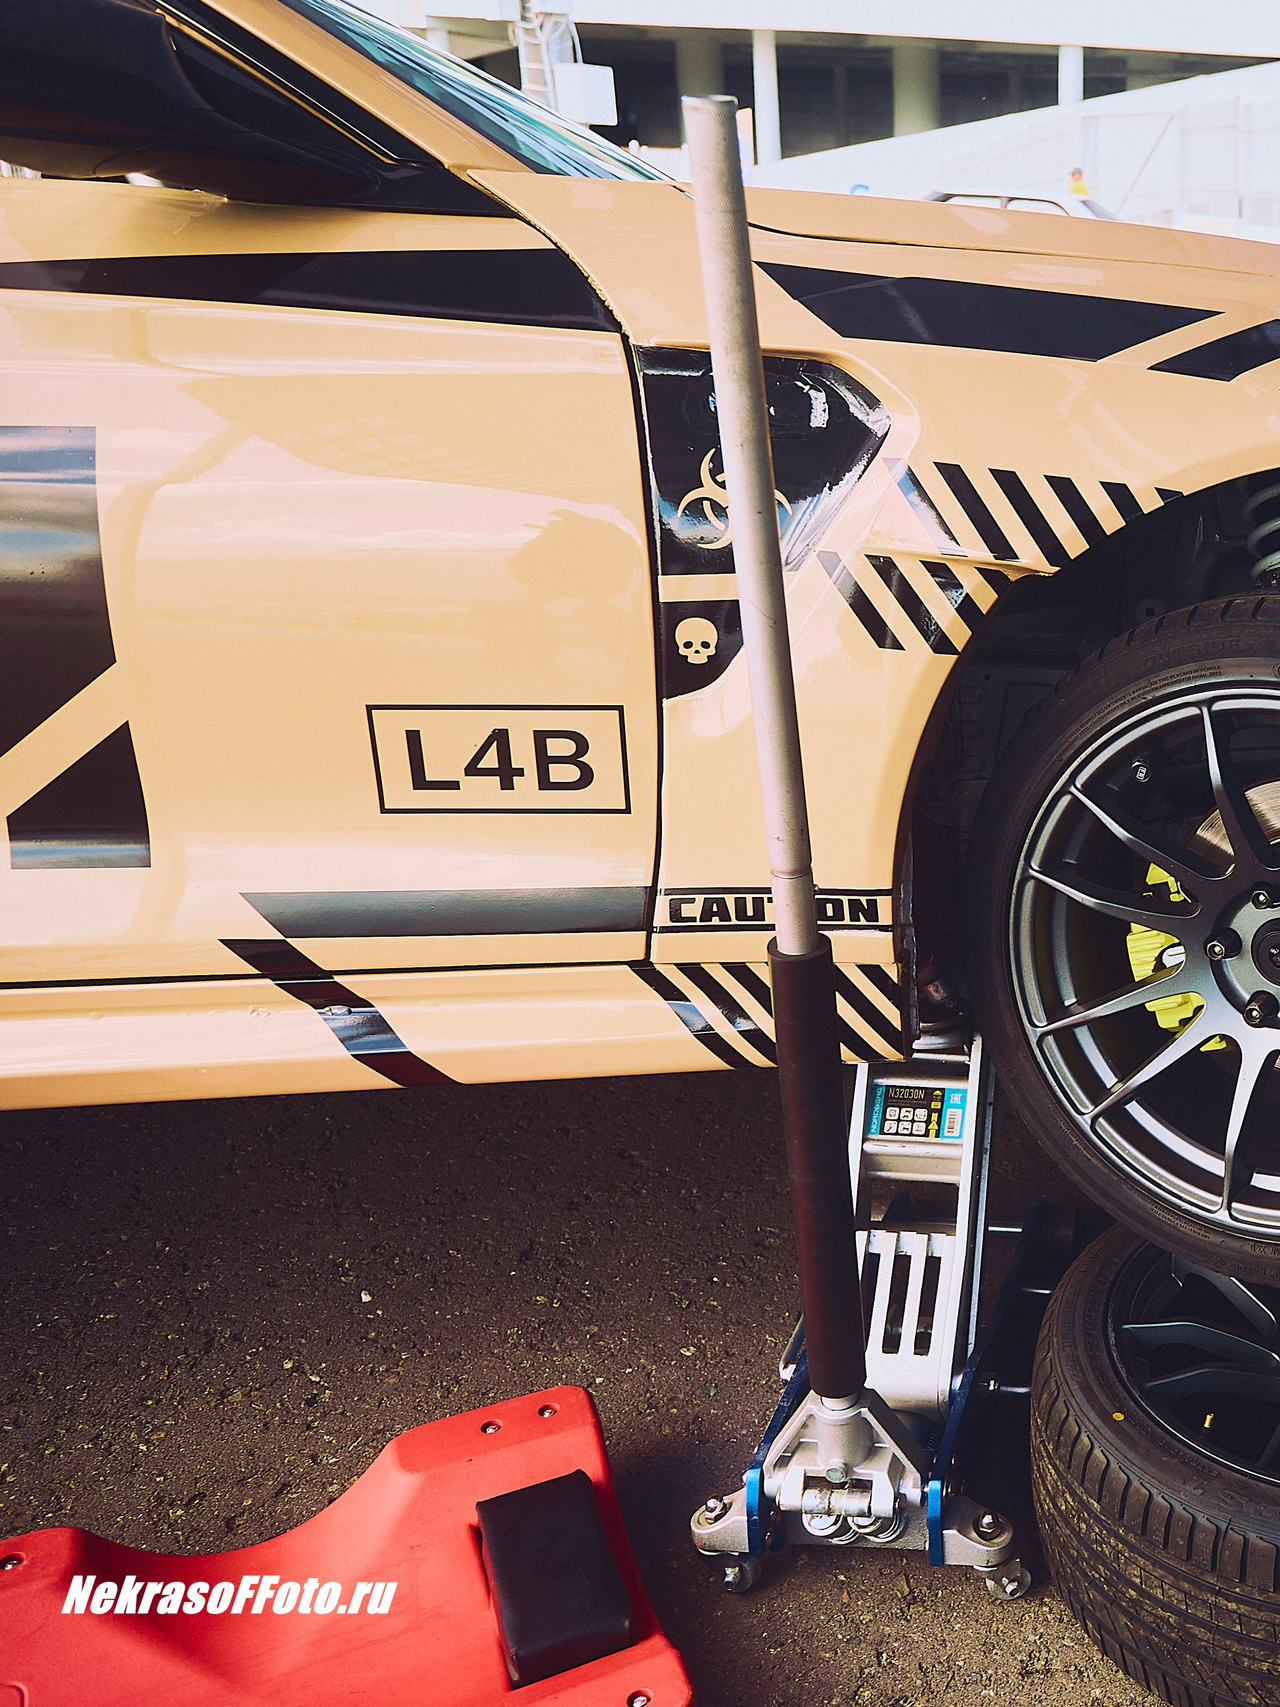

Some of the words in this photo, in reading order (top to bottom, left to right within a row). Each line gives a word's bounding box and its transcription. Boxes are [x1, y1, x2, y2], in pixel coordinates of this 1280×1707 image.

[1143, 636, 1240, 670] OUTSIDE
[405, 728, 595, 790] L4B
[669, 897, 879, 923] CAUON
[888, 1087, 925, 1099] N32030N
